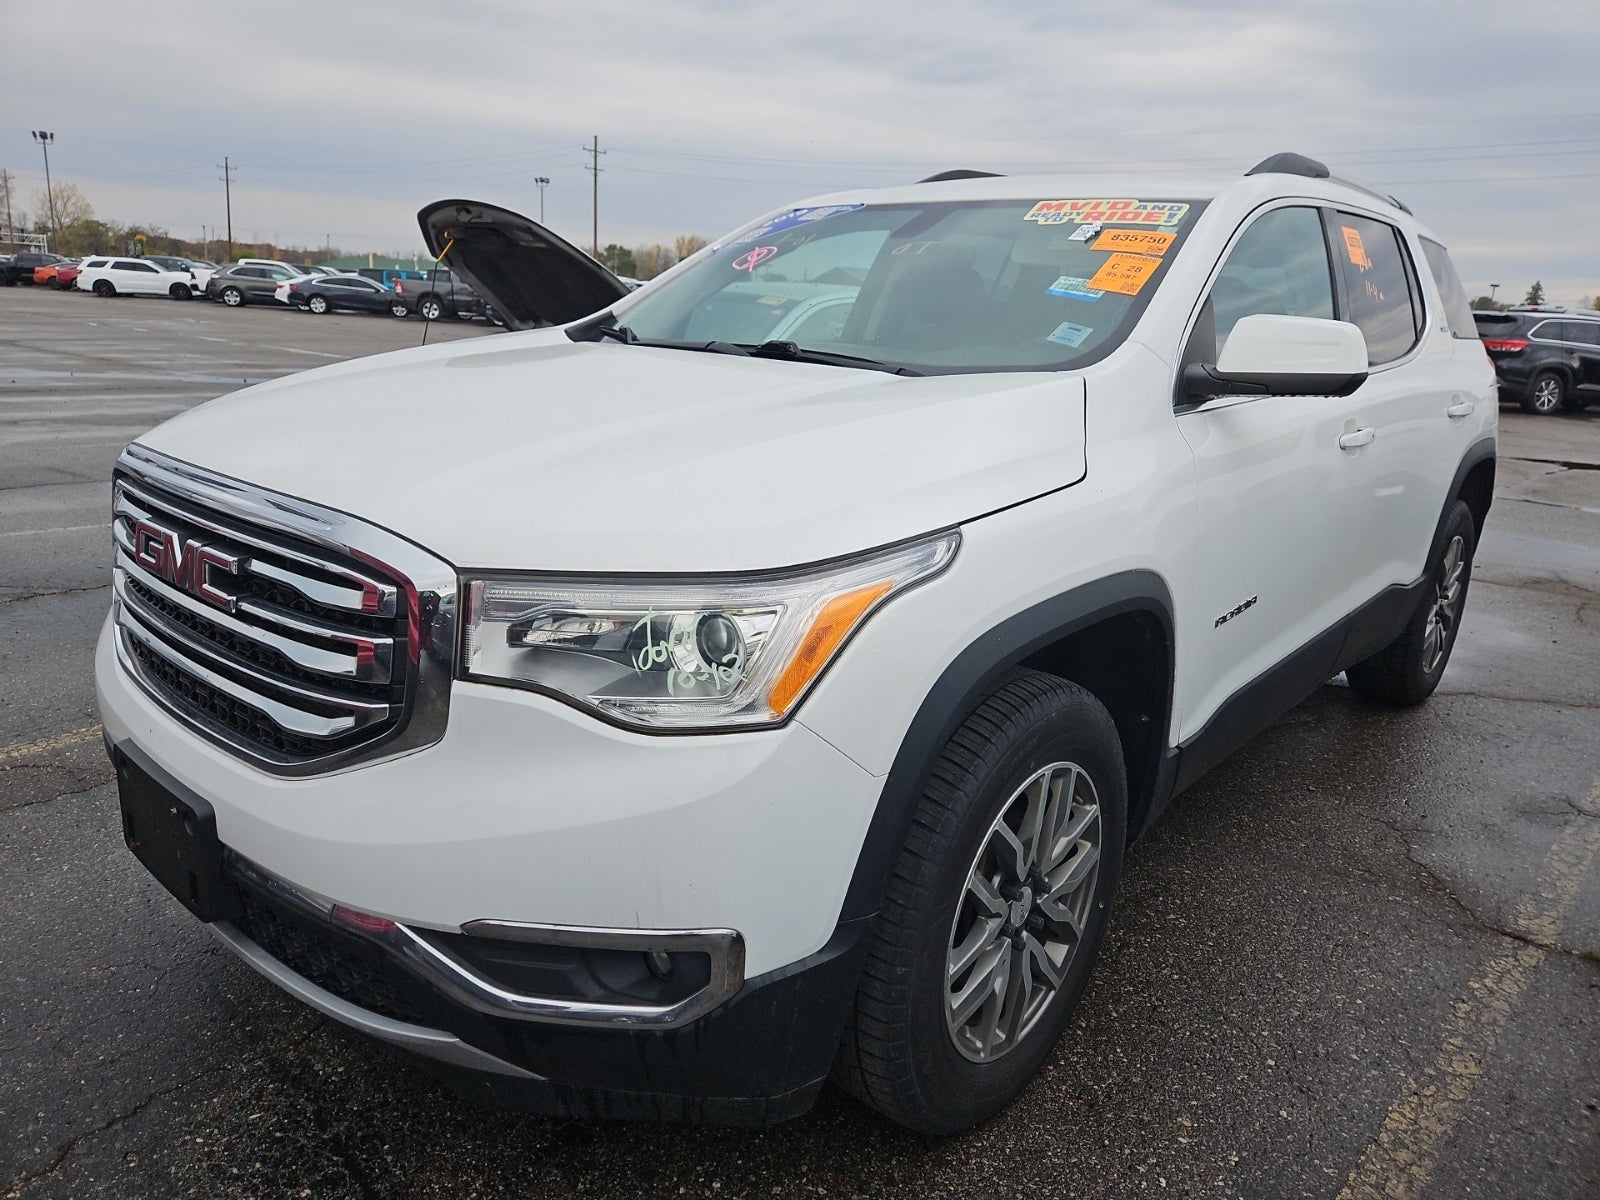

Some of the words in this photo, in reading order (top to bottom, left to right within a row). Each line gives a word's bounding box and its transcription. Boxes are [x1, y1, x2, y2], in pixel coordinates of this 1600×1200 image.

[1080, 210, 1178, 223] RIDE!
[1110, 233, 1168, 244] 835750
[1127, 265, 1143, 273] 28
[135, 519, 238, 613] GMC
